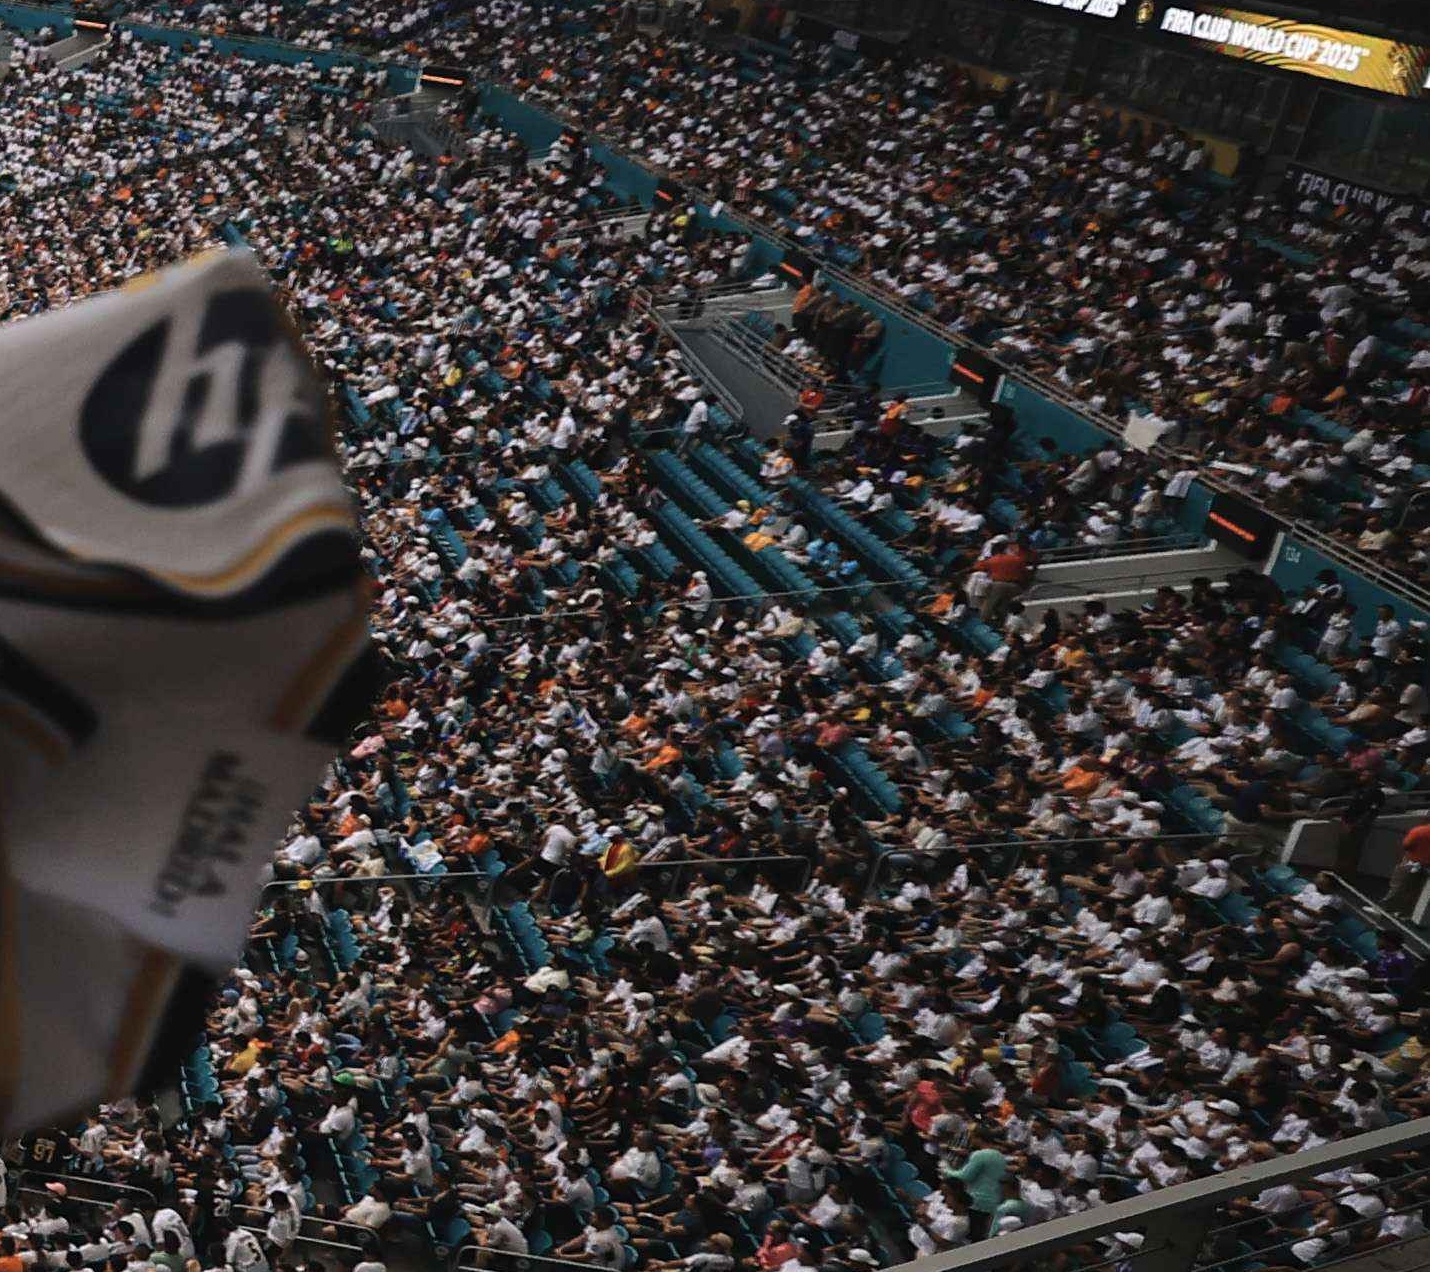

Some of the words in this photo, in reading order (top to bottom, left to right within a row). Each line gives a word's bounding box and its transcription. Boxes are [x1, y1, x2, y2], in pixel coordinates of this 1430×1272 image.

[1160, 8, 1195, 35] FIFA
[1193, 13, 1229, 43] CLUB
[1230, 21, 1287, 54] WORLD
[1282, 33, 1318, 61] CUP
